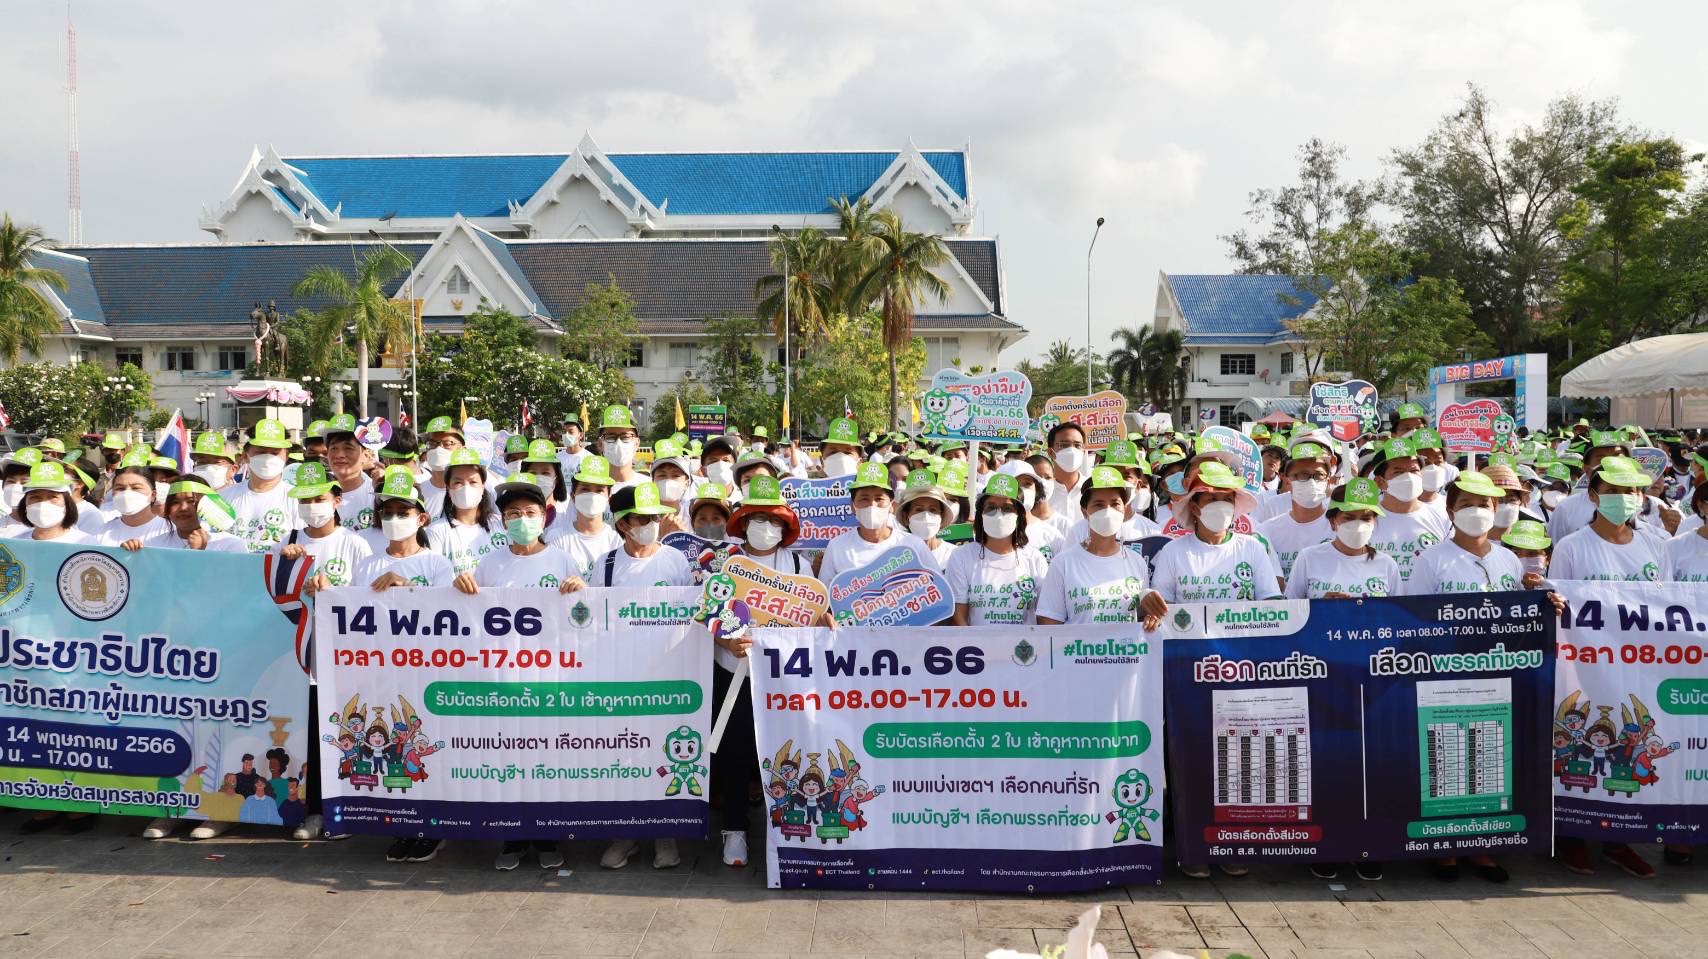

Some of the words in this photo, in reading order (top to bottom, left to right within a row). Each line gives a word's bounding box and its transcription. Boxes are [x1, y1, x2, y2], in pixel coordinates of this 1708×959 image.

[1446, 366, 1469, 381] BIG
[1474, 359, 1504, 378] DAY
[971, 377, 1026, 396] อย่าลืม!
[1401, 542, 1415, 551] 66
[999, 584, 1013, 594] 66
[1217, 574, 1232, 584] 66
[1348, 584, 1362, 593] 66
[1441, 581, 1453, 592] 14
[745, 589, 812, 626] ส.ส.ที่ดี
[865, 585, 942, 626] ำลายชาติ
[1215, 607, 1289, 624] #ไทยโหวต
[1437, 598, 1502, 621] เลือกตั้ง
[1510, 604, 1542, 618] ส.ส.
[331, 605, 378, 636] 14
[389, 606, 471, 637] พ.ค.
[483, 607, 543, 637] 66
[1617, 604, 1707, 631] พ.ค.
[1326, 630, 1342, 641] 14
[1347, 629, 1375, 640] พ.ค.
[1377, 627, 1392, 639] 66
[1396, 628, 1417, 639] เวลา
[1418, 625, 1475, 637] 08.00-17.00
[1476, 625, 1487, 635] น.
[1490, 623, 1525, 634] รับบัตร
[1526, 624, 1532, 632] 2
[1532, 621, 1543, 632] ใบ
[334, 647, 385, 667] เวลา
[391, 649, 552, 669] 08.00-17.00
[559, 651, 583, 668] น.
[1063, 638, 1148, 657] #ไทยโหวต
[764, 647, 813, 678] 14
[825, 648, 911, 677] พ.ค.
[924, 646, 985, 676] 66
[1196, 656, 1254, 681] เลือก
[1258, 652, 1326, 679] คนที่รัก
[1371, 648, 1429, 674] เลือก
[1433, 644, 1542, 671] พรรคที่ชอบ
[436, 687, 540, 709] รับบัตรเลือกตั้ง
[546, 692, 555, 707] 2
[559, 690, 575, 708] ใบ
[581, 689, 691, 713] เข้าคูหากากบาท
[766, 690, 821, 711] เวลา
[828, 688, 996, 710] 08.00-17.00
[1003, 690, 1027, 709] น.
[7, 725, 30, 742] 14
[36, 731, 118, 751] พฤษภาคม
[125, 735, 176, 754] 2566
[451, 732, 549, 751] แบบแบ่งเขตฯ
[555, 727, 651, 751] เลือกคนที่รัก
[876, 727, 985, 749] รับบัตรเลือกตั้ง
[991, 733, 1000, 748] 2
[1005, 731, 1021, 749] ใบ
[1027, 730, 1139, 754] เข้าคูหากากบาท
[8, 749, 25, 762] น.
[47, 749, 93, 767] 17.00
[97, 755, 113, 769] น.
[451, 760, 526, 783] แบบบัญชีฯ
[531, 756, 652, 780] เลือกพรรคที่ชอบ
[892, 775, 994, 794] แบบแบ่งเขตฯ
[1000, 770, 1100, 795] เลือกคนที่รัก
[892, 807, 970, 829] แบบบัญชีฯ
[976, 804, 1101, 827] เลือกพรรคที่ชอบ
[1422, 818, 1511, 835] บัตรเลือกตั้งสีเขียว
[1217, 827, 1309, 840] บัตรเลือกตั้งสีม่วง
[1405, 840, 1429, 851] เลือก
[1433, 840, 1452, 850] ส.ส.
[1456, 832, 1528, 849] แบบบัญชีรายชื่อ
[1209, 845, 1233, 856] เลือก
[1237, 847, 1257, 855] ส.ส.
[1262, 845, 1317, 855] แบบแบ่งเขต
